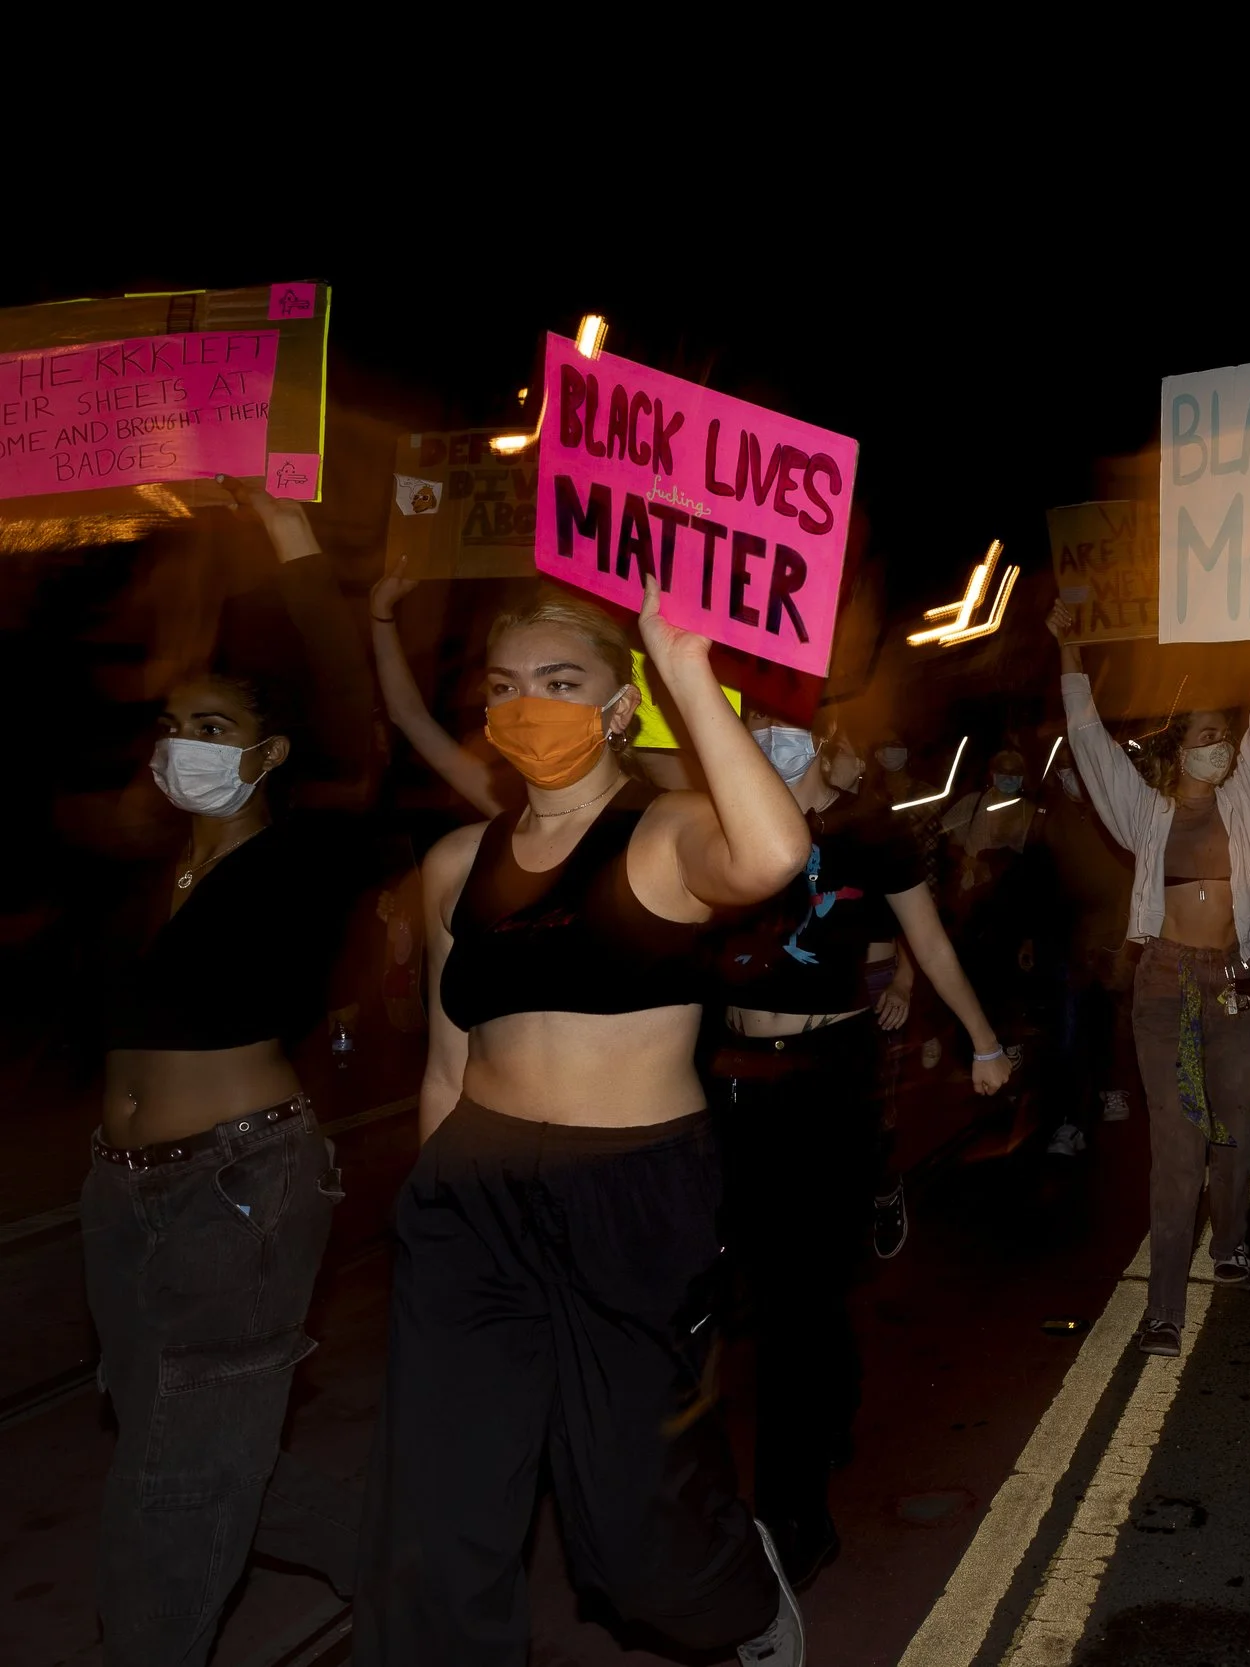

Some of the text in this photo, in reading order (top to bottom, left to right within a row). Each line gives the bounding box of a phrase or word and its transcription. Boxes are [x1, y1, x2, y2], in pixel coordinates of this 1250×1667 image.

[95, 341, 174, 381] KKK
[182, 334, 275, 366] LEFT
[2, 370, 253, 426] EIR SHEETS AT
[55, 421, 109, 450] AND
[116, 409, 202, 440] BROUGHT
[214, 401, 269, 422] THEIR
[560, 363, 843, 536] BLACK LIVES
[49, 440, 177, 482] BADGES
[646, 474, 712, 518] fucking
[553, 474, 810, 644] MATTER
